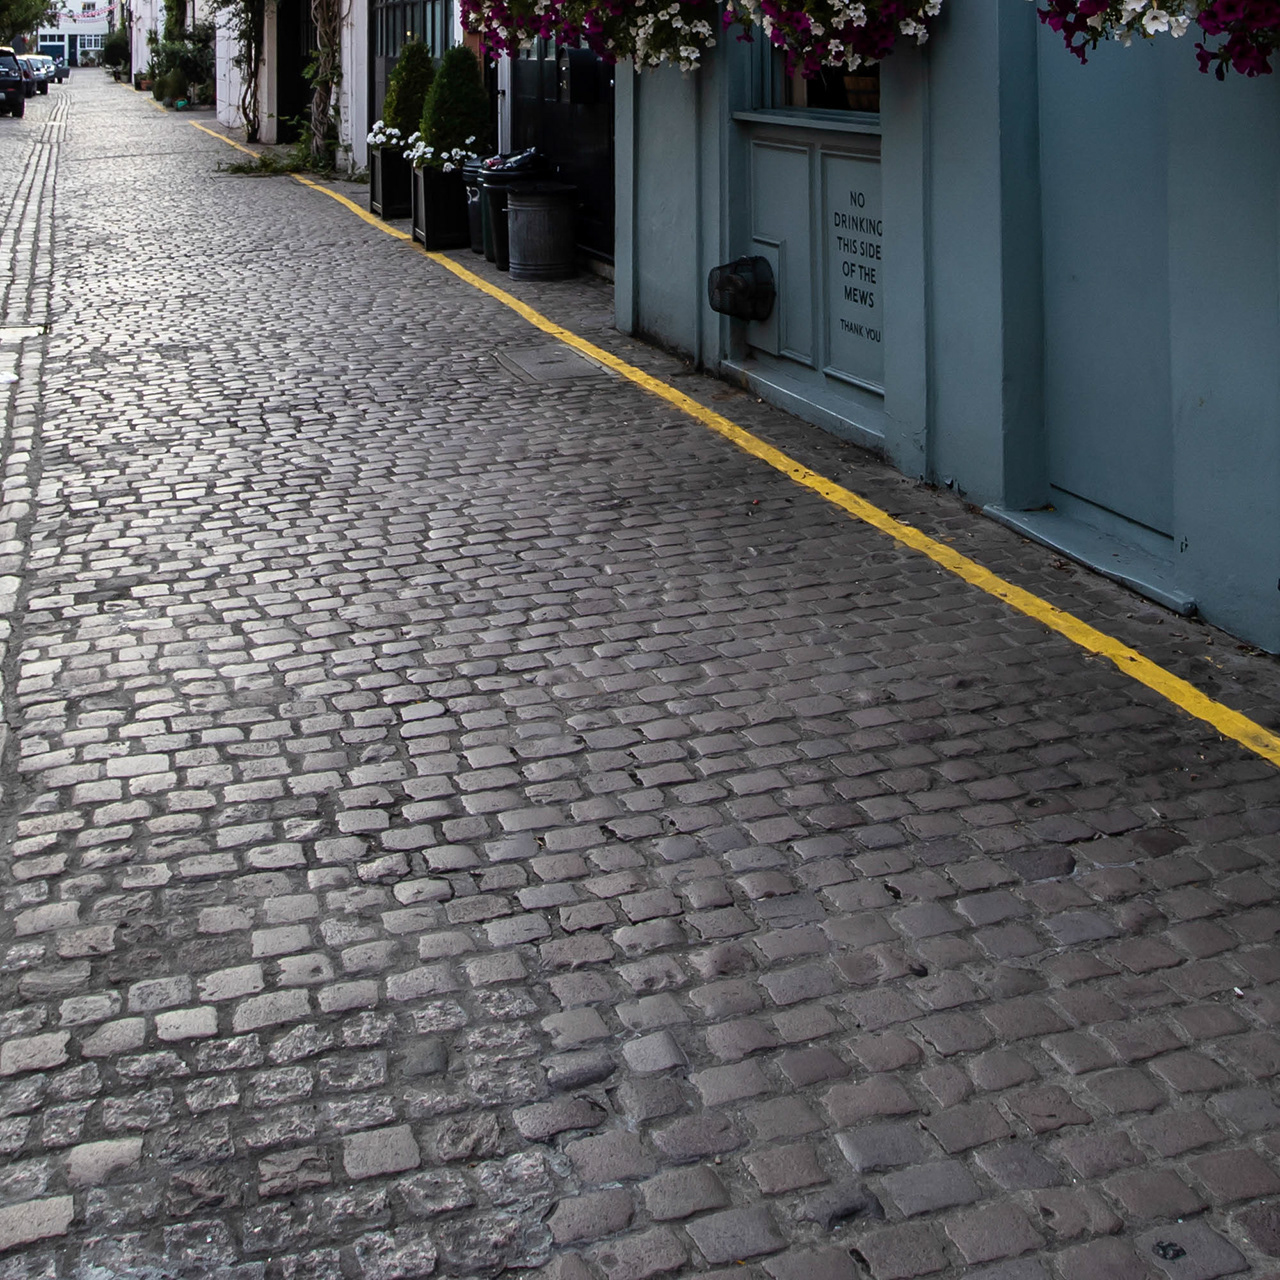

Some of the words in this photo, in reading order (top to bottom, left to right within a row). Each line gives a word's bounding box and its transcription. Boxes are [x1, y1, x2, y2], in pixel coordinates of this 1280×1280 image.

[850, 191, 865, 208] NO
[835, 212, 883, 237] DRINKING
[837, 237, 857, 255] THIS
[860, 241, 881, 260] SIDE
[842, 261, 856, 278] OF
[859, 265, 876, 284] THE
[844, 285, 874, 308] MEWS
[840, 319, 863, 337] THANK
[866, 327, 881, 342] YOU
